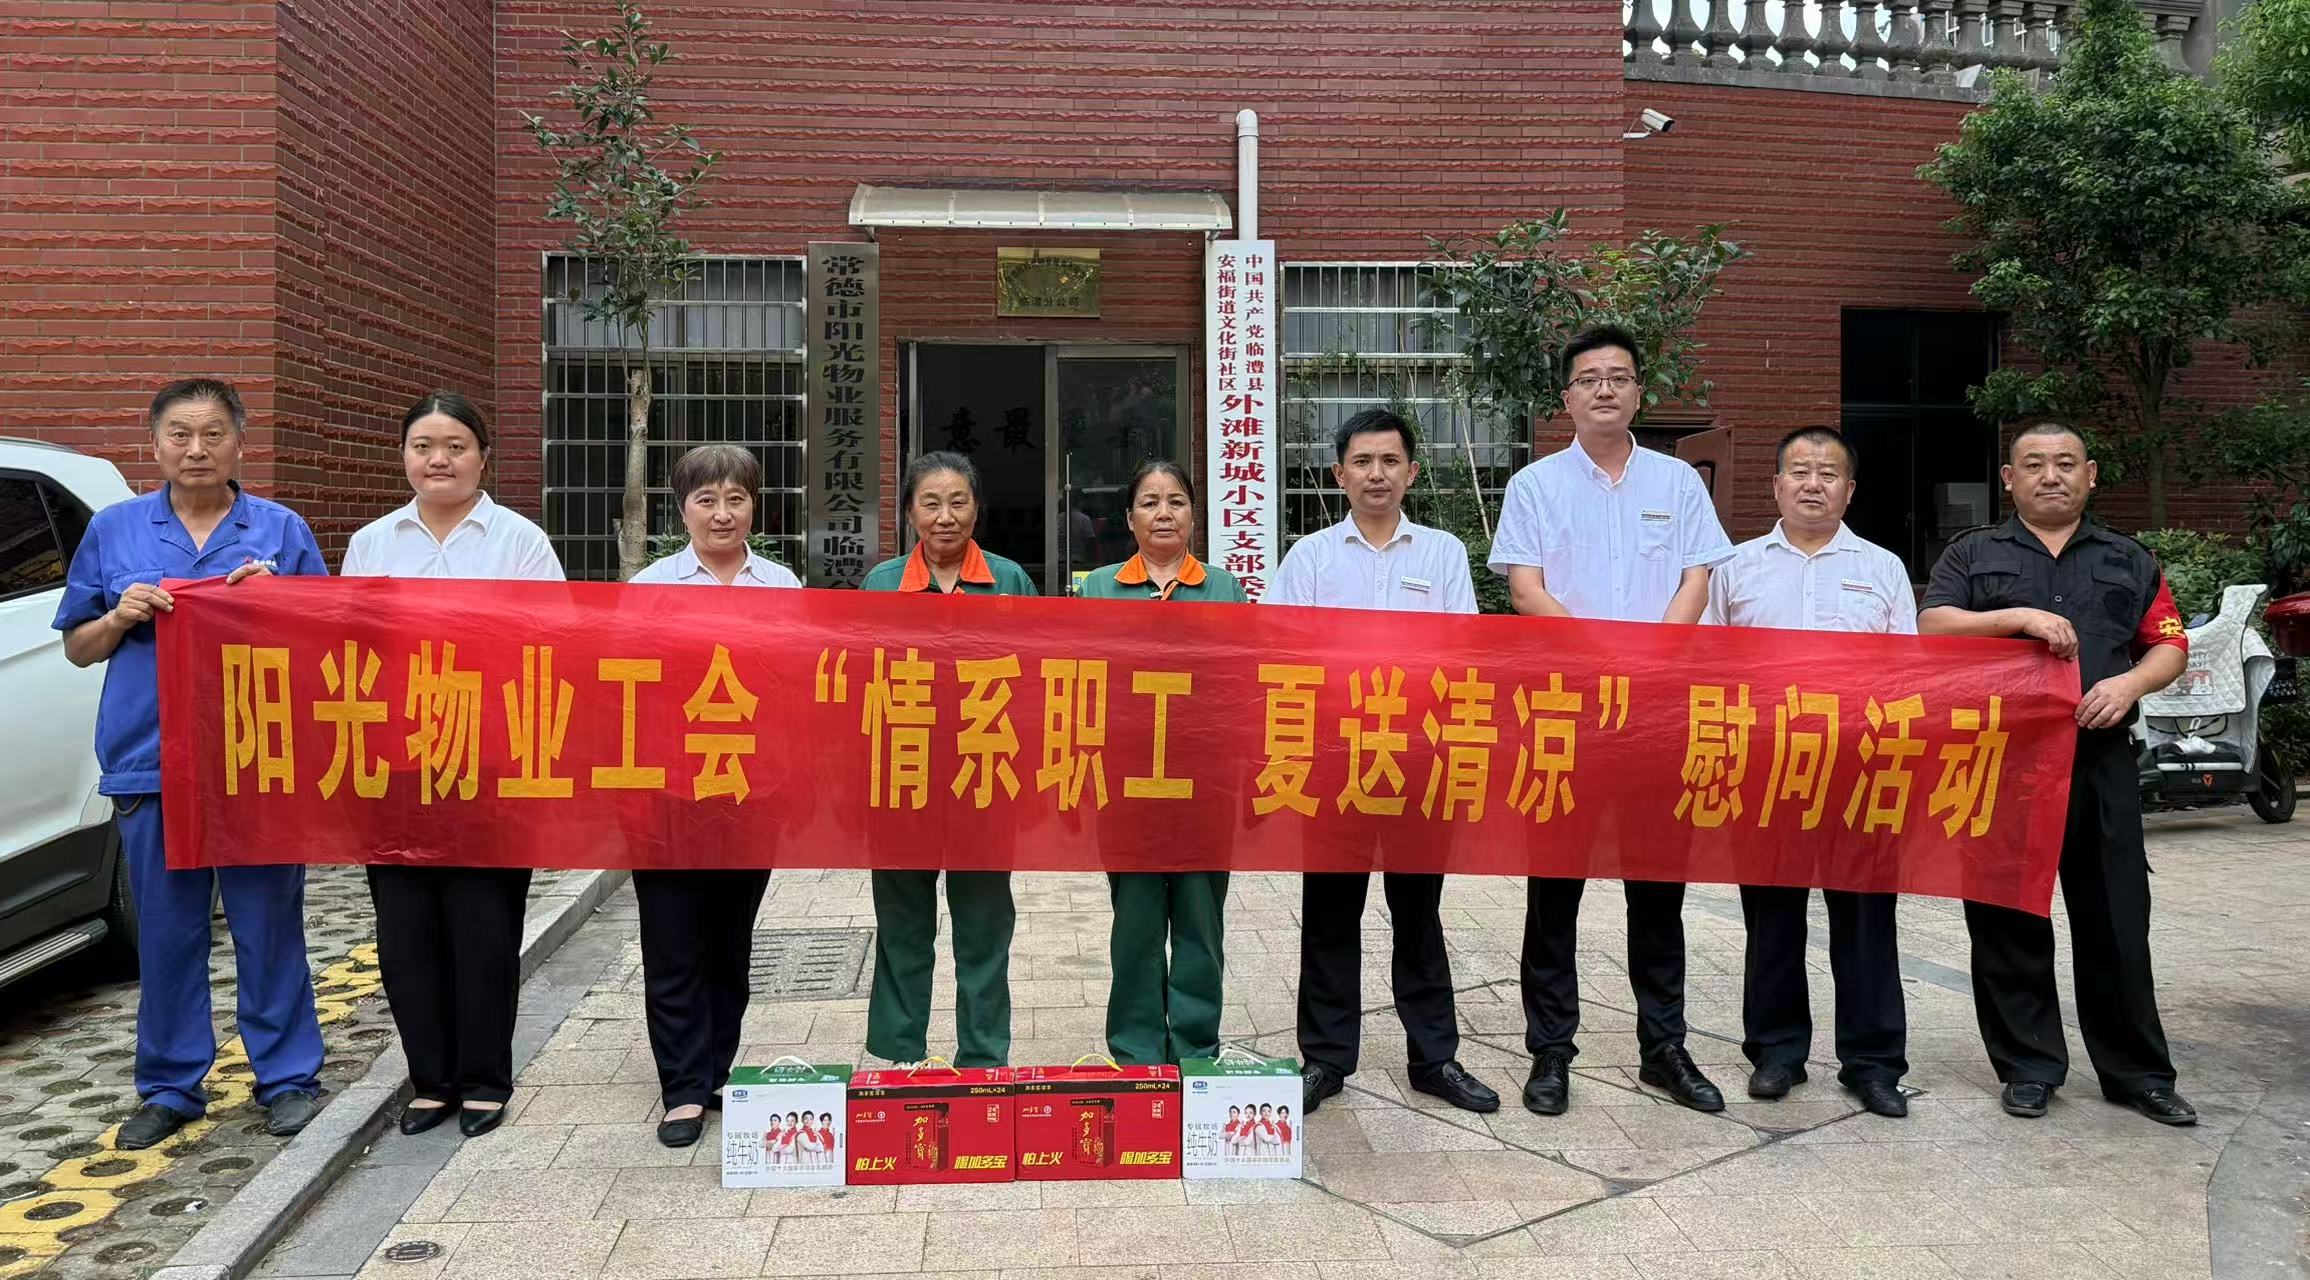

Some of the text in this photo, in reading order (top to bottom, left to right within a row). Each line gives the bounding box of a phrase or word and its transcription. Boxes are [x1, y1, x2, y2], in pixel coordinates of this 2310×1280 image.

[1217, 253, 1237, 391] 安福街道文化街社区
[1245, 253, 1265, 391] 中国共产党临澧县
[726, 1140, 759, 1166] 纯牛奶
[1186, 1131, 1218, 1157] 纯牛奶
[855, 1157, 897, 1171] 怕上火
[954, 1155, 1008, 1170] 喝加多宝
[1022, 1152, 1064, 1166] 怕上火
[1119, 1151, 1173, 1165] 喝加多宝
